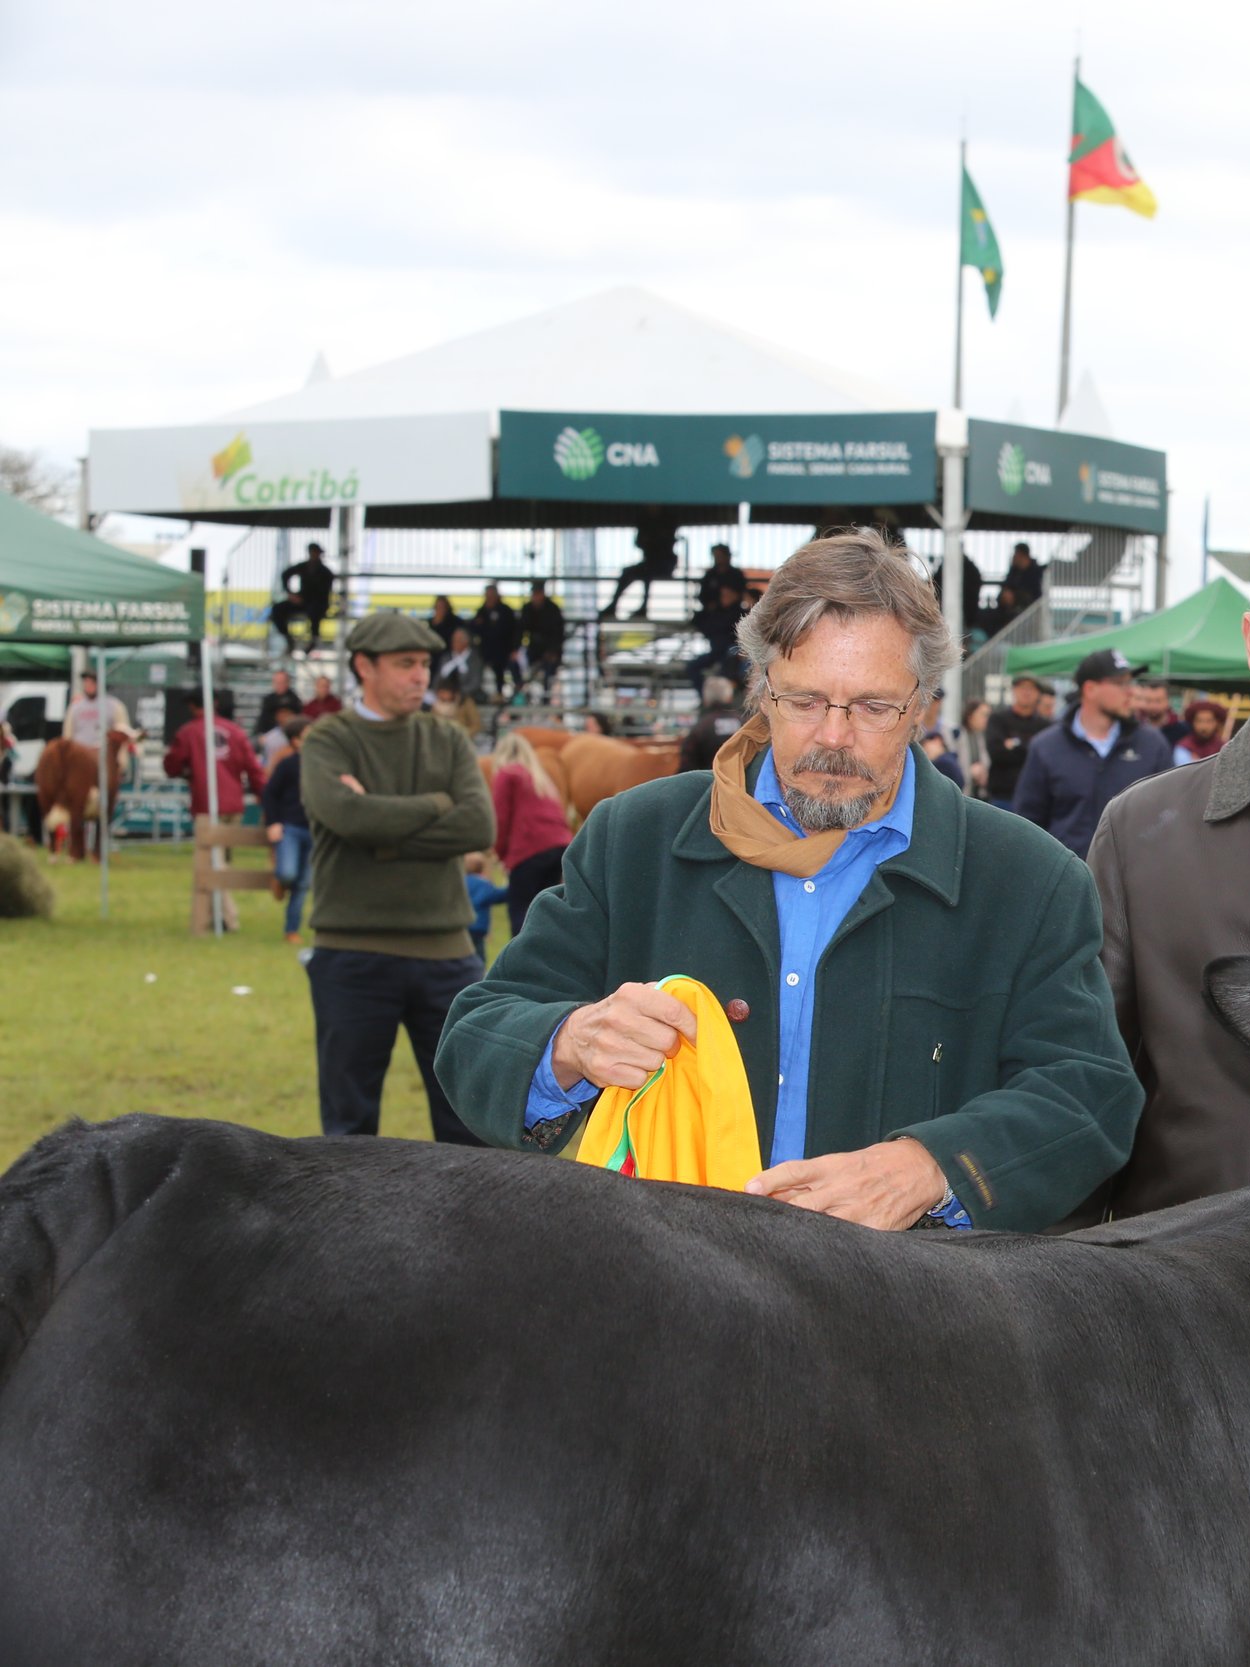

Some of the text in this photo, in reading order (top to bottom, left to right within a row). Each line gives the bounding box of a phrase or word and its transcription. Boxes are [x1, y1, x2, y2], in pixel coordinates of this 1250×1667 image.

[606, 442, 660, 467] CNA
[767, 441, 911, 460] SISTEMA FARSUL
[234, 468, 360, 503] Cotribá
[1024, 460, 1052, 486] CNA
[32, 599, 116, 619] SISTEMA
[116, 600, 190, 620] FARSUL
